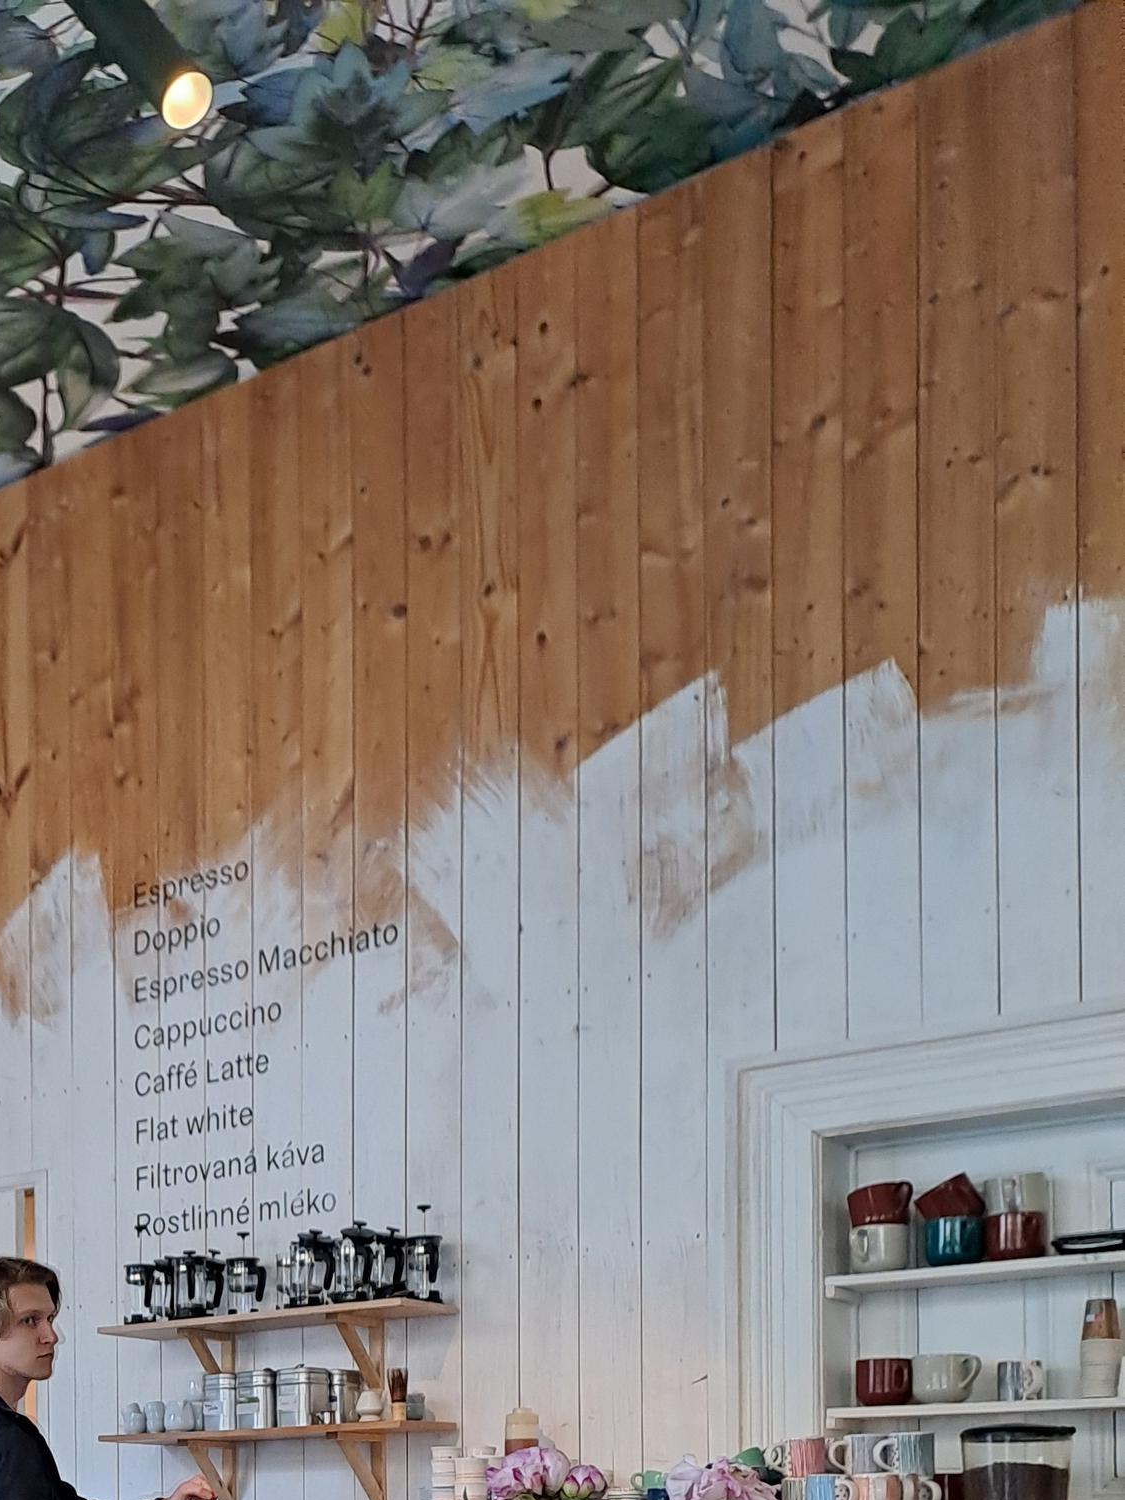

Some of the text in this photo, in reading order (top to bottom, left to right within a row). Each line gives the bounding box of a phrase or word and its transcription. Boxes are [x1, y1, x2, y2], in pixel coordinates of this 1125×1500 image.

[132, 859, 250, 909] Espresso
[133, 915, 222, 956] Doppio
[133, 921, 400, 1003] Espresso Macchiato
[134, 1000, 283, 1050] Cappuccino
[134, 1051, 270, 1097] Caffé Latte
[135, 1104, 255, 1145] Flat white
[135, 1140, 326, 1192] Filtrovaná káva
[135, 1187, 338, 1239] Rostlinné mléko
